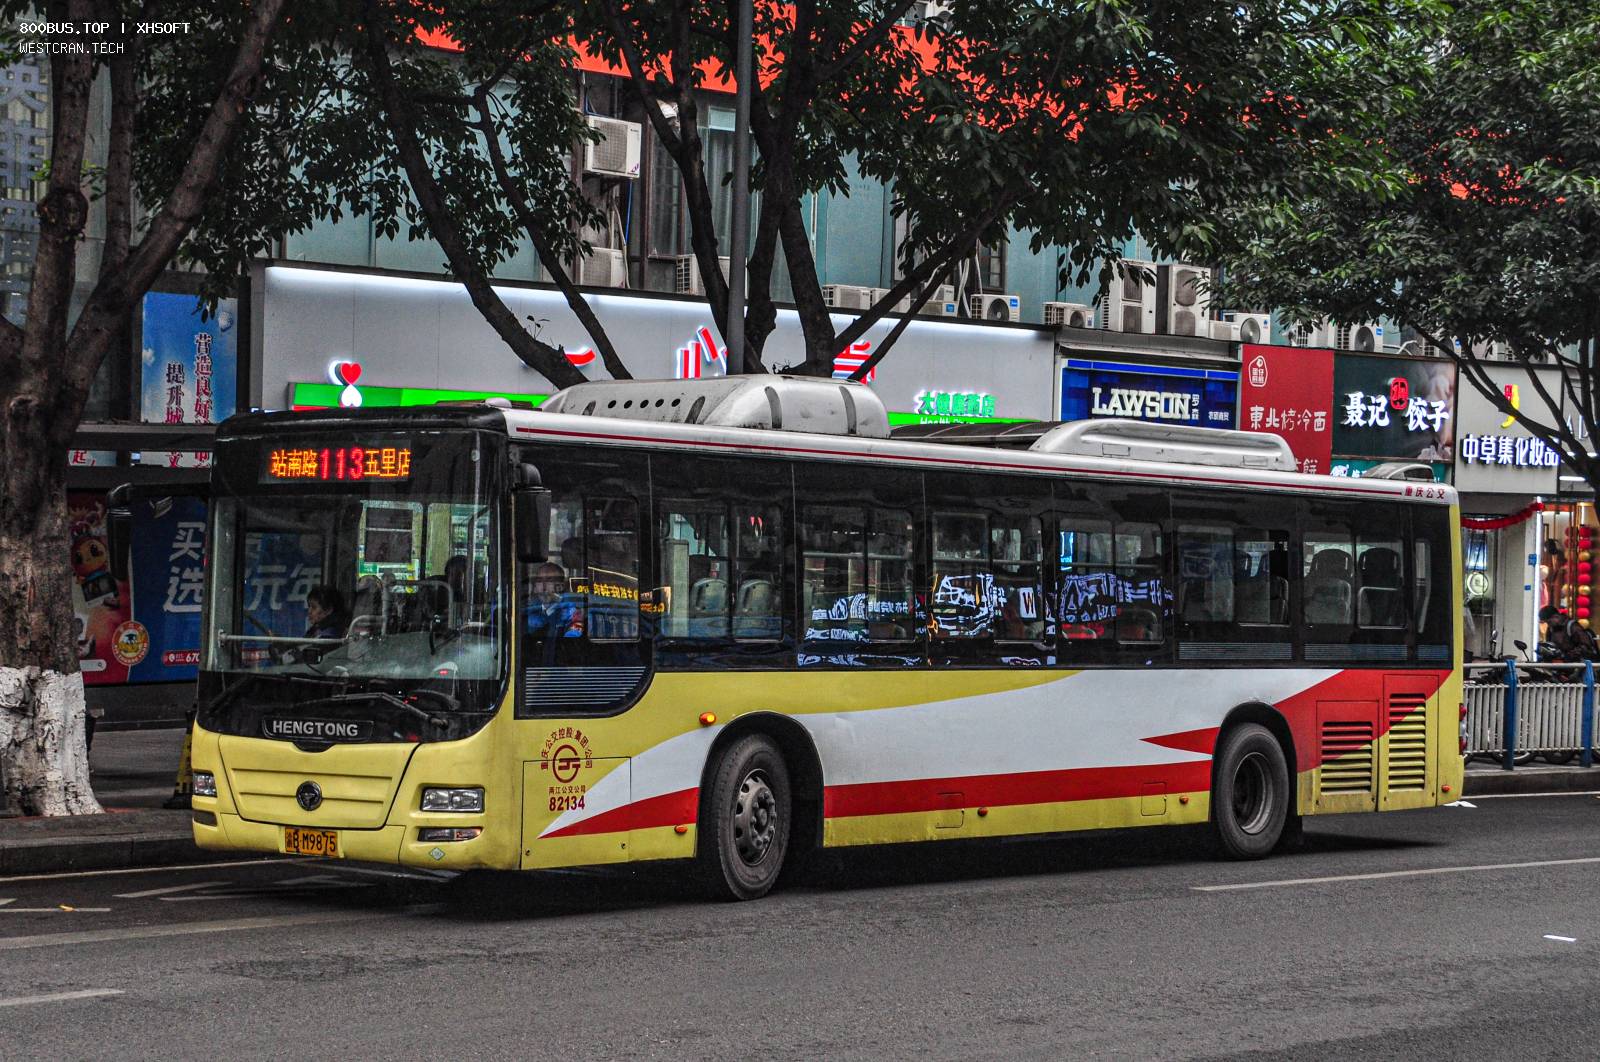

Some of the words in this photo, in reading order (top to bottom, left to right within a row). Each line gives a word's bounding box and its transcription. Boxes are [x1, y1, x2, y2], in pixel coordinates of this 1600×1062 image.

[1091, 387, 1192, 421] LAWSON
[1191, 393, 1200, 420] 罗森
[1405, 396, 1450, 432] 饺子
[1404, 486, 1446, 500] 重庆公交
[272, 720, 358, 737] HENGTONG
[548, 796, 586, 812] 82134
